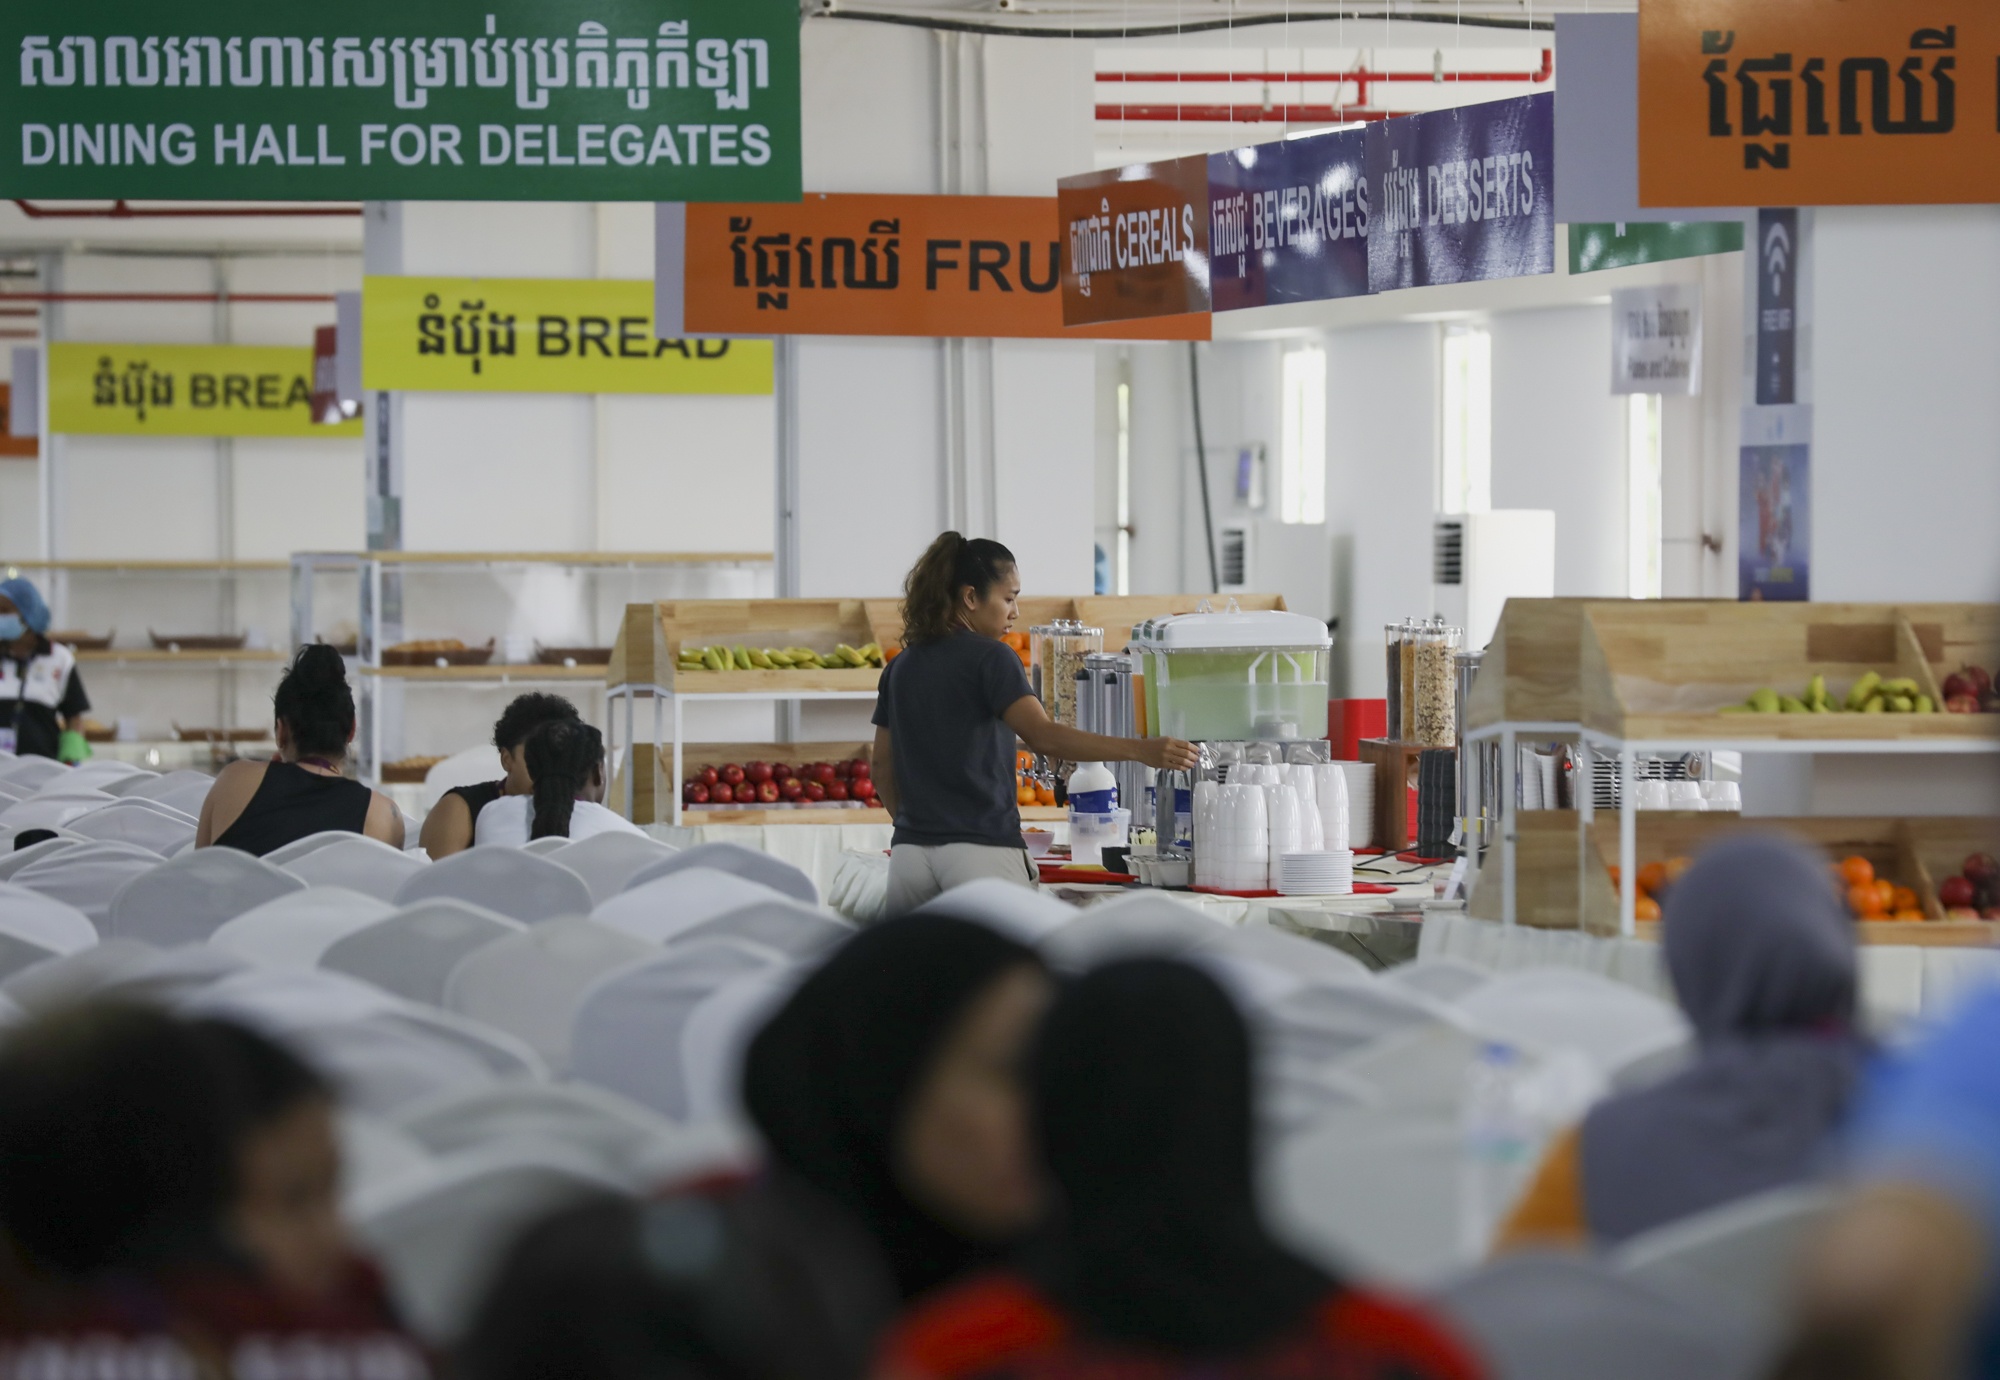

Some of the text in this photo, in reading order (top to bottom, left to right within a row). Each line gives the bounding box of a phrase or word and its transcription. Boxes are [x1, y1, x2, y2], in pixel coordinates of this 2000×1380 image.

[1702, 24, 1957, 170] ផ្លែឈើ
[21, 123, 772, 166] DINING HALL FOR DELEGATES
[1252, 177, 1368, 251] BEVERAGES
[1427, 150, 1535, 227] DESSERTS
[728, 216, 901, 311] ផ្លែឈើ
[1115, 203, 1195, 270] CEREALS
